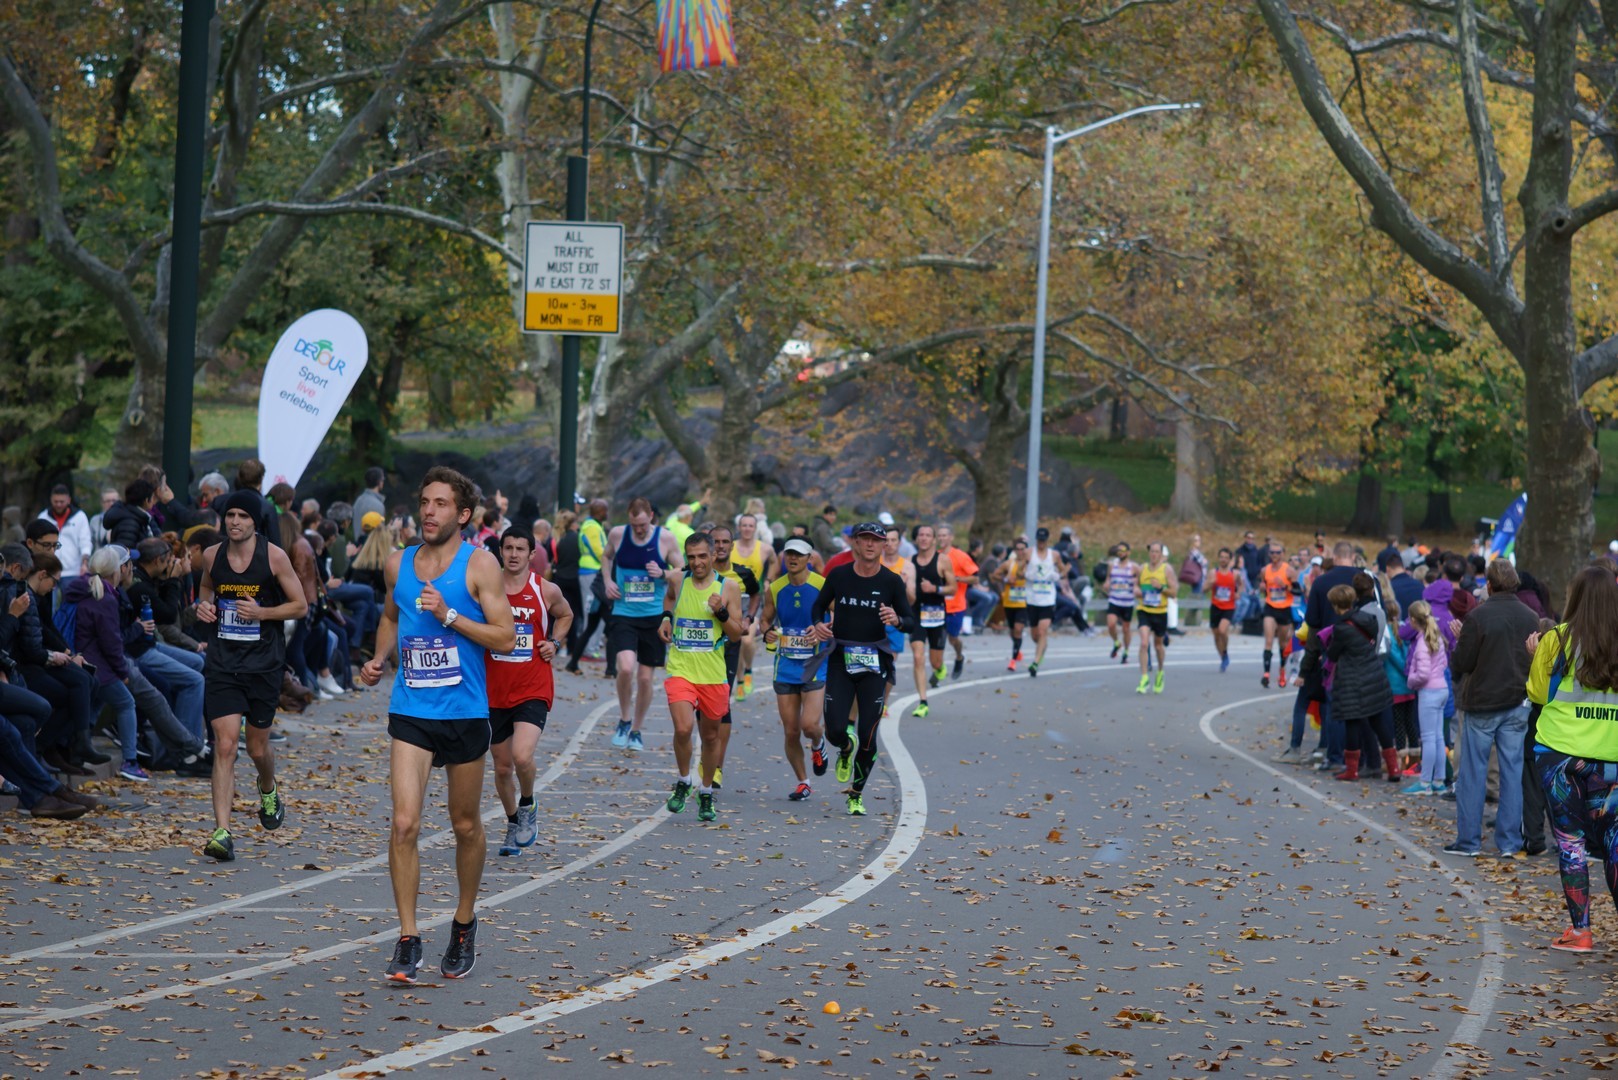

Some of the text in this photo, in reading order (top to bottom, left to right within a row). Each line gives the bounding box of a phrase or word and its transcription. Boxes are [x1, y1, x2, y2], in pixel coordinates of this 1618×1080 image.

[565, 231, 584, 243] ALL
[554, 246, 594, 258] TRAFFIC
[547, 262, 599, 274] MUST EXIT
[535, 277, 611, 290] AT EAST 72 ST
[540, 313, 563, 325] MON
[587, 315, 603, 326] FRI
[294, 338, 346, 377] DERTOUR
[298, 365, 329, 389] Sport
[296, 381, 316, 398] live
[279, 389, 320, 416] erleben
[220, 584, 260, 594] PROVIDENCE
[687, 629, 709, 640] 3395
[419, 651, 449, 668] 1034
